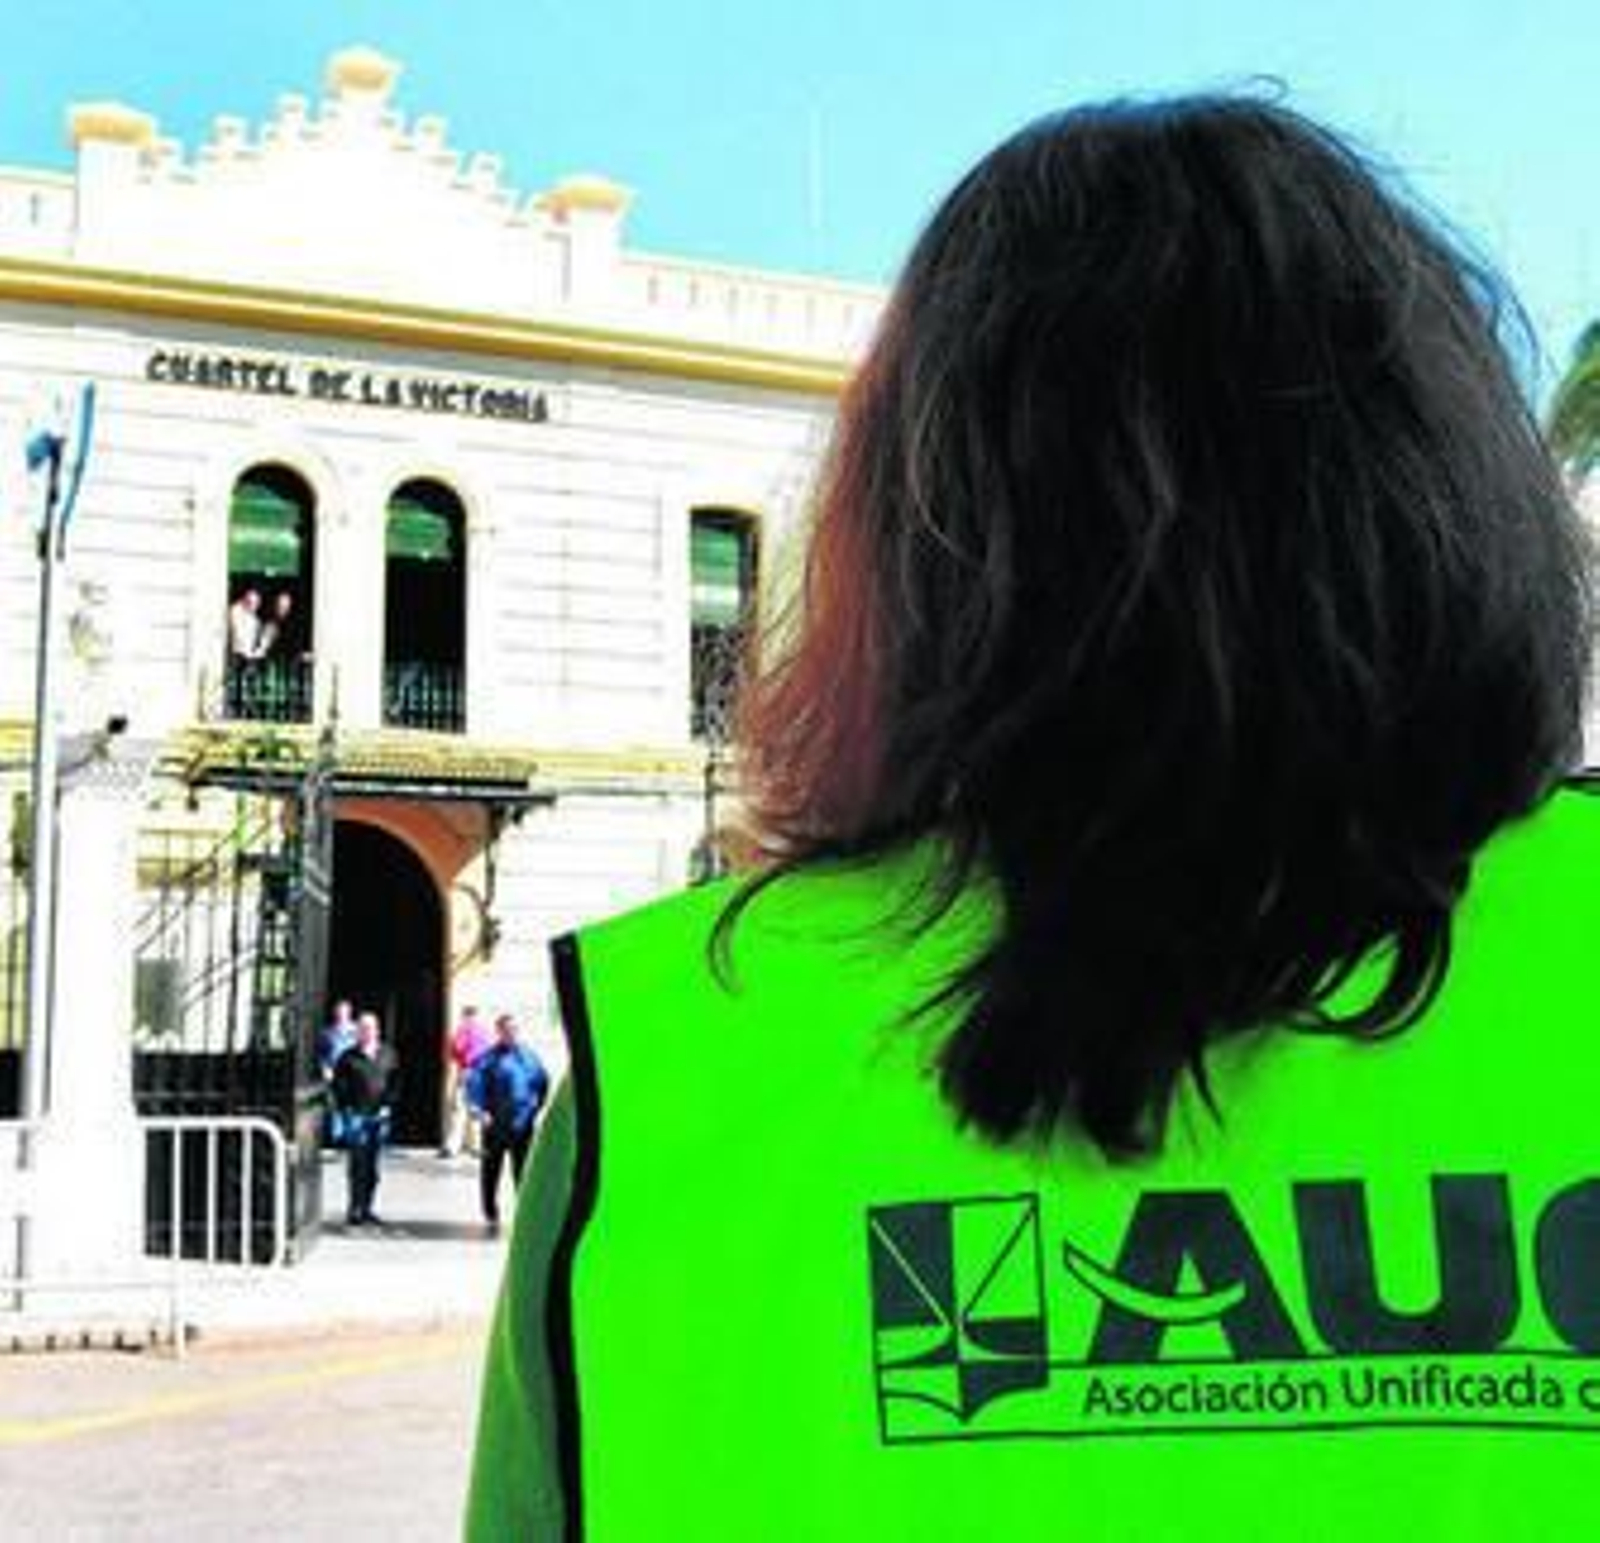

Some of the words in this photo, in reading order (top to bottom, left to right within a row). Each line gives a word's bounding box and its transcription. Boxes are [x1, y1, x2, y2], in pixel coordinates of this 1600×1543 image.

[145, 350, 298, 395] CUARTEL
[308, 368, 351, 400] DE
[361, 374, 400, 405] LA
[408, 379, 548, 423] VICTORIA
[1083, 1372, 1328, 1416] Asociación
[1340, 1362, 1565, 1410] Unificada
